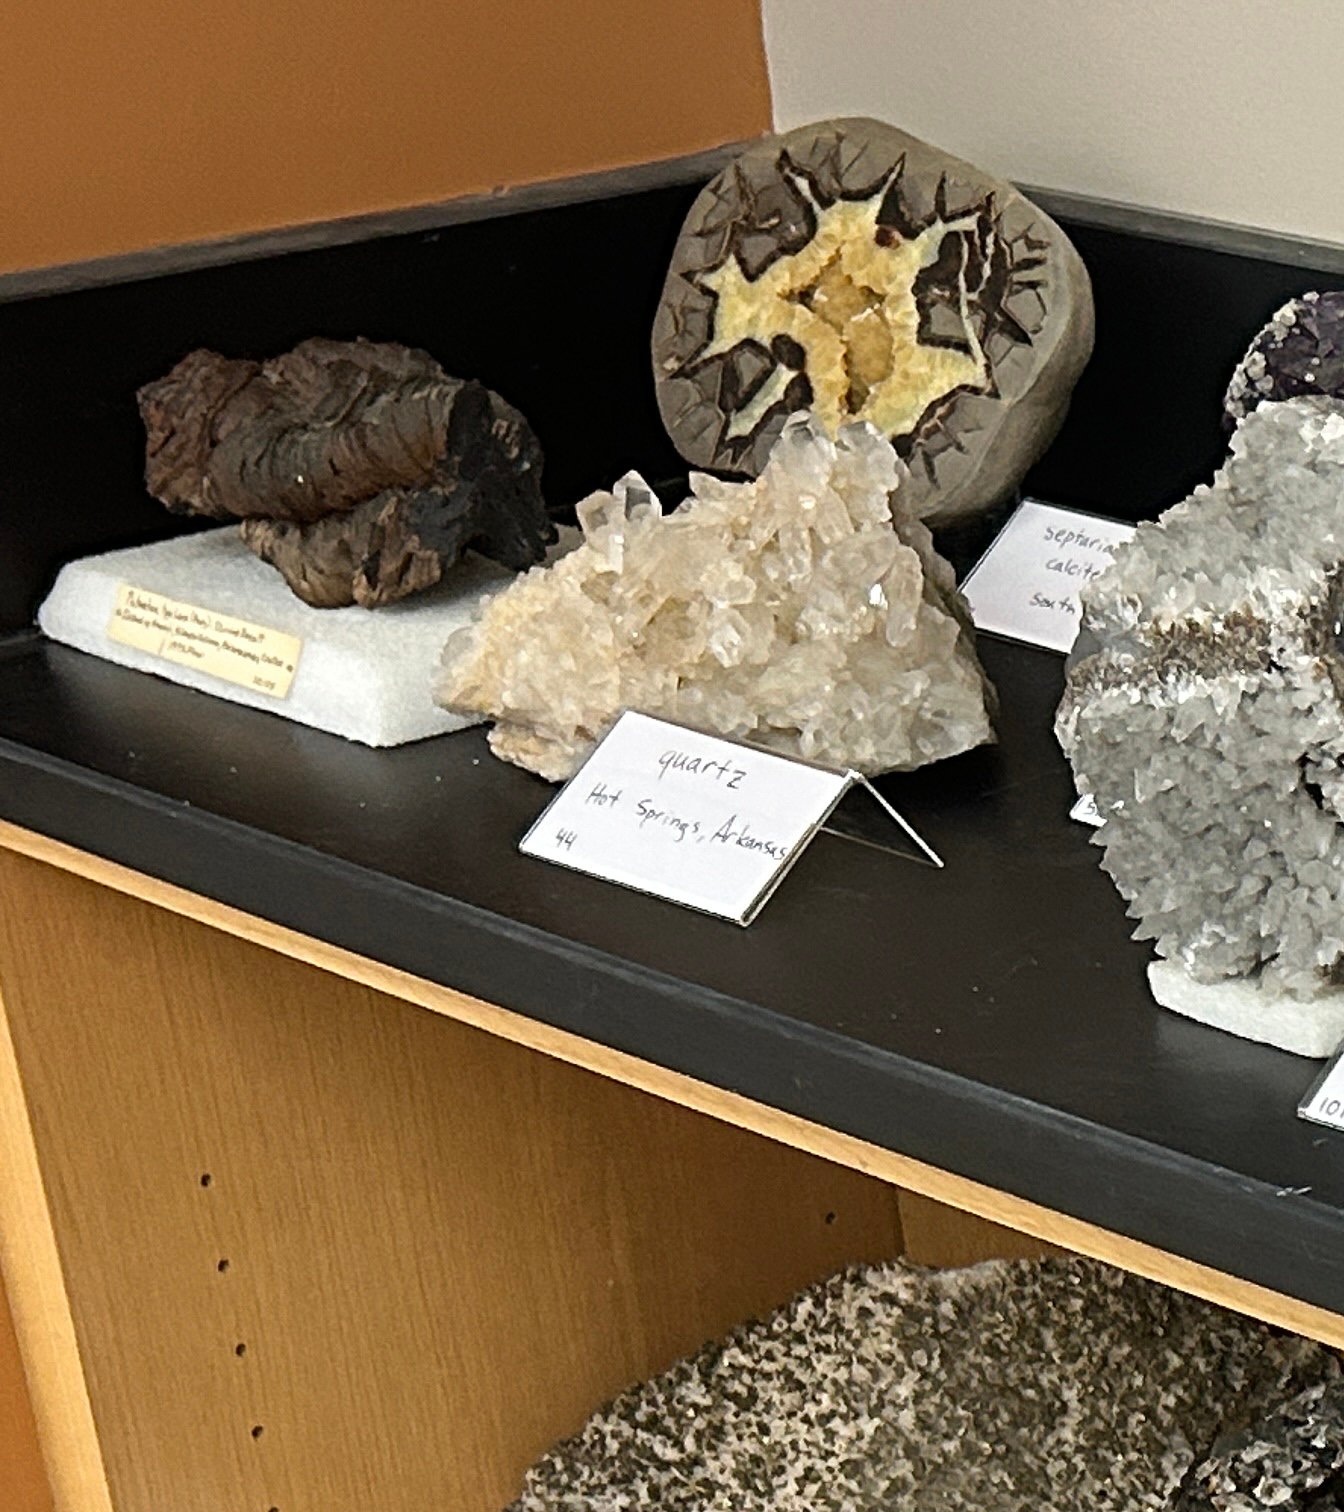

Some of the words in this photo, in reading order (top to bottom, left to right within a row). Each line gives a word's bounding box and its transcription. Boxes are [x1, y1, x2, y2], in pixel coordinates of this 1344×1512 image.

[658, 748, 748, 790] quartz
[555, 826, 579, 851] 44
[586, 782, 622, 808] Hot
[711, 813, 787, 860] Arkansas
